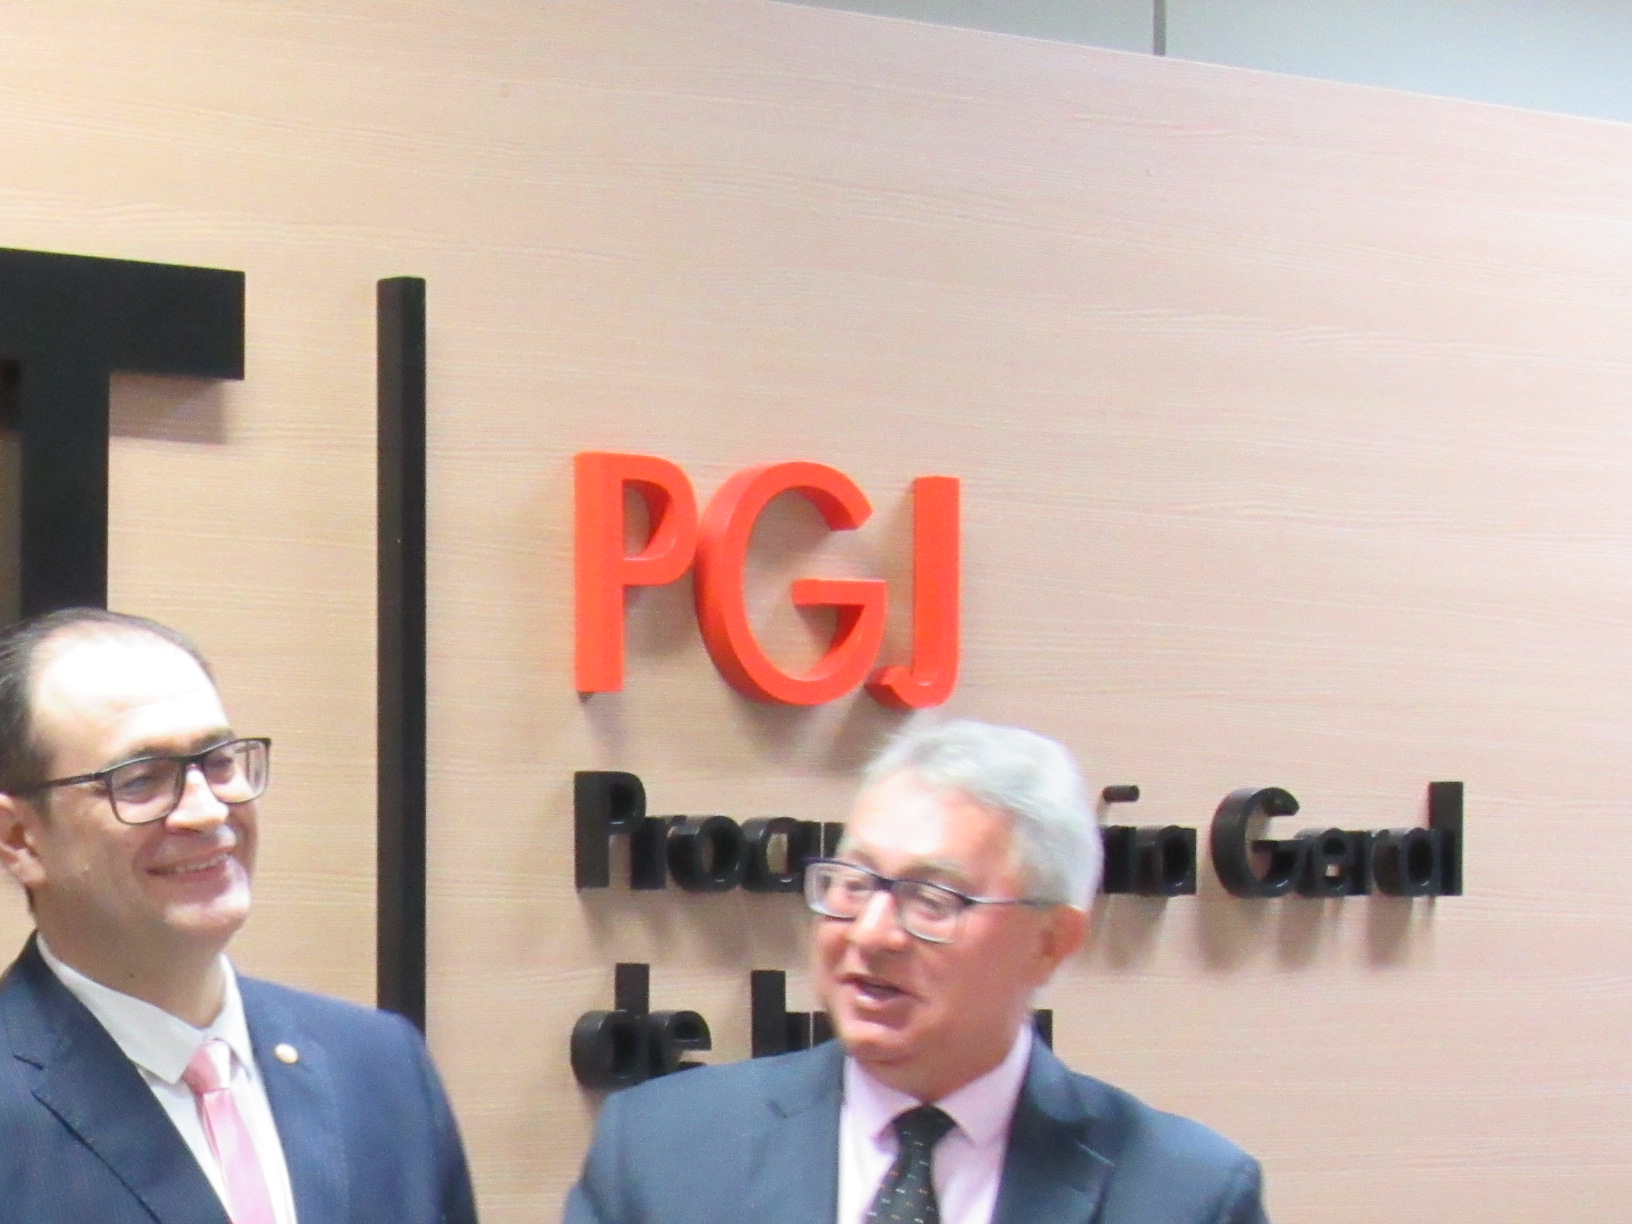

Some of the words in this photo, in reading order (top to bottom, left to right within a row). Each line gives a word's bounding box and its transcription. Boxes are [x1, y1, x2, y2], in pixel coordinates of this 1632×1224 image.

[573, 452, 960, 708] PGJ
[1211, 781, 1463, 897] Geral
[571, 963, 710, 1087] de
